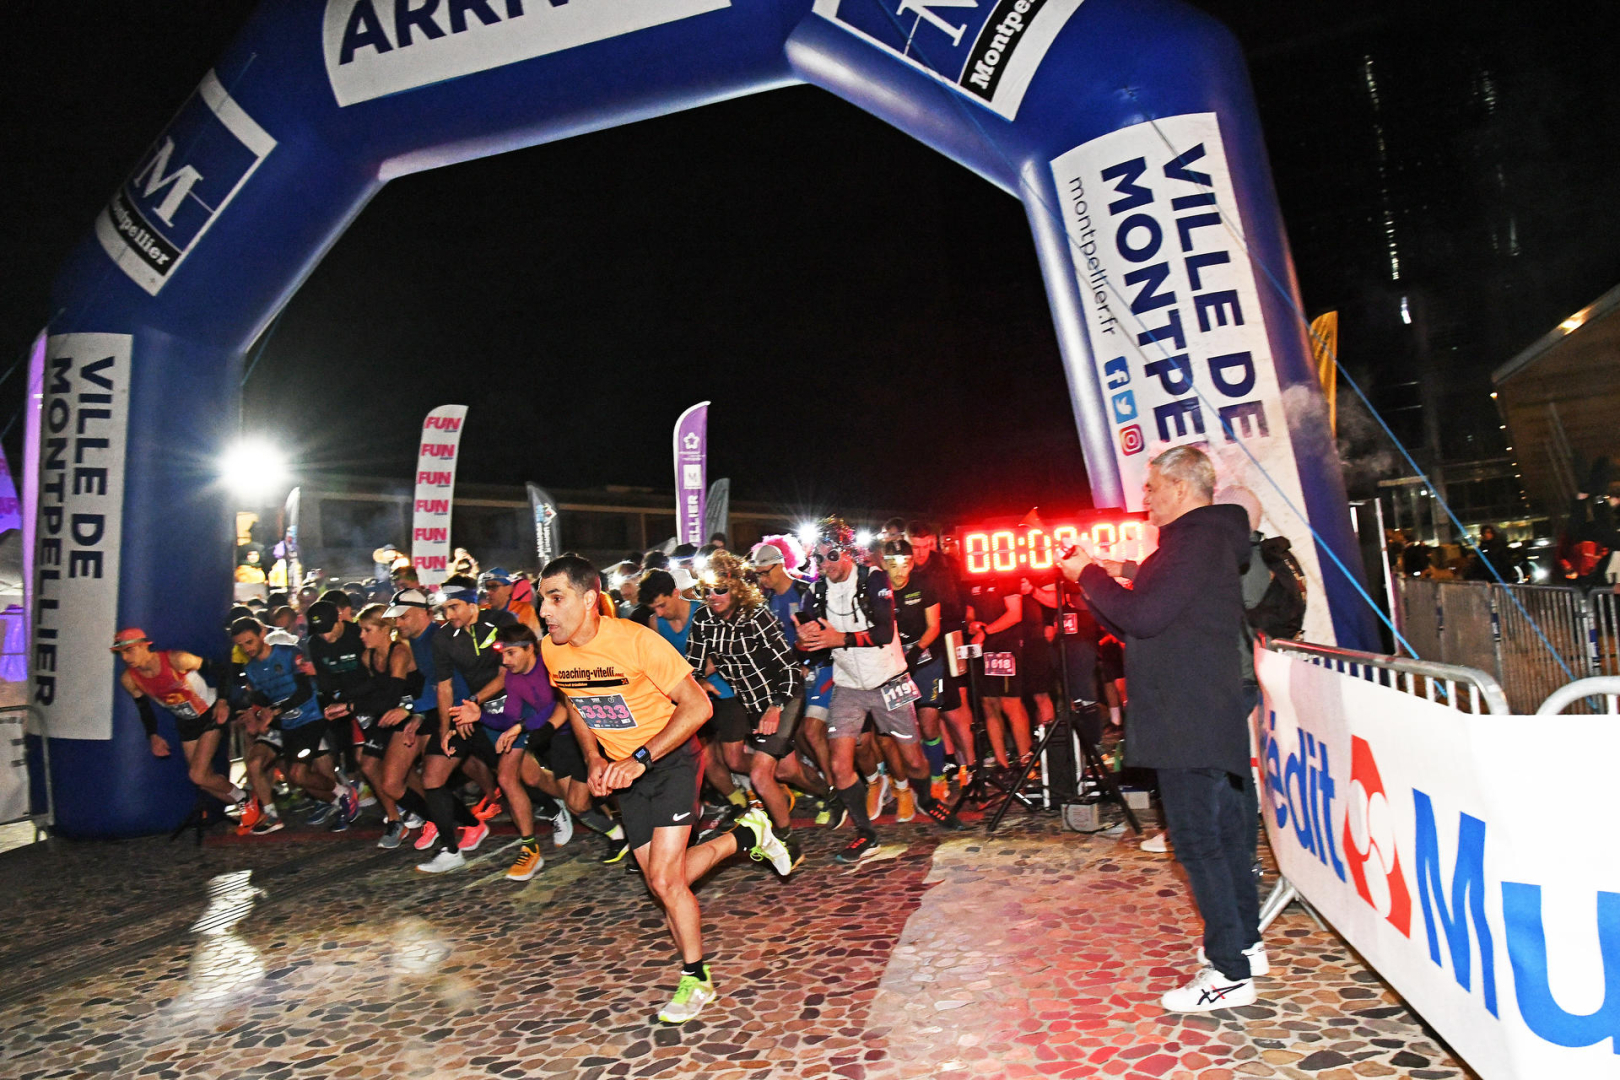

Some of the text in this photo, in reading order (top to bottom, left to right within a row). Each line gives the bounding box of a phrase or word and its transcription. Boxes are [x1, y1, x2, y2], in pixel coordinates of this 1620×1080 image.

[969, 0, 1035, 90] Montpe
[134, 135, 204, 228] M
[1068, 176, 1117, 337] montpellier.fr
[1100, 156, 1209, 447] MONTPE
[1162, 142, 1271, 445] VILLE DE
[68, 356, 115, 579] VILLE DE
[420, 443, 455, 457] FUN
[424, 416, 462, 430] FUN
[415, 499, 449, 513] FUN
[417, 471, 452, 485] FUN
[35, 357, 73, 706] MONTPELLIER
[413, 527, 447, 541] FUN
[413, 555, 447, 569] FUN
[581, 704, 630, 720] 3333
[1412, 787, 1620, 1056] Mu
